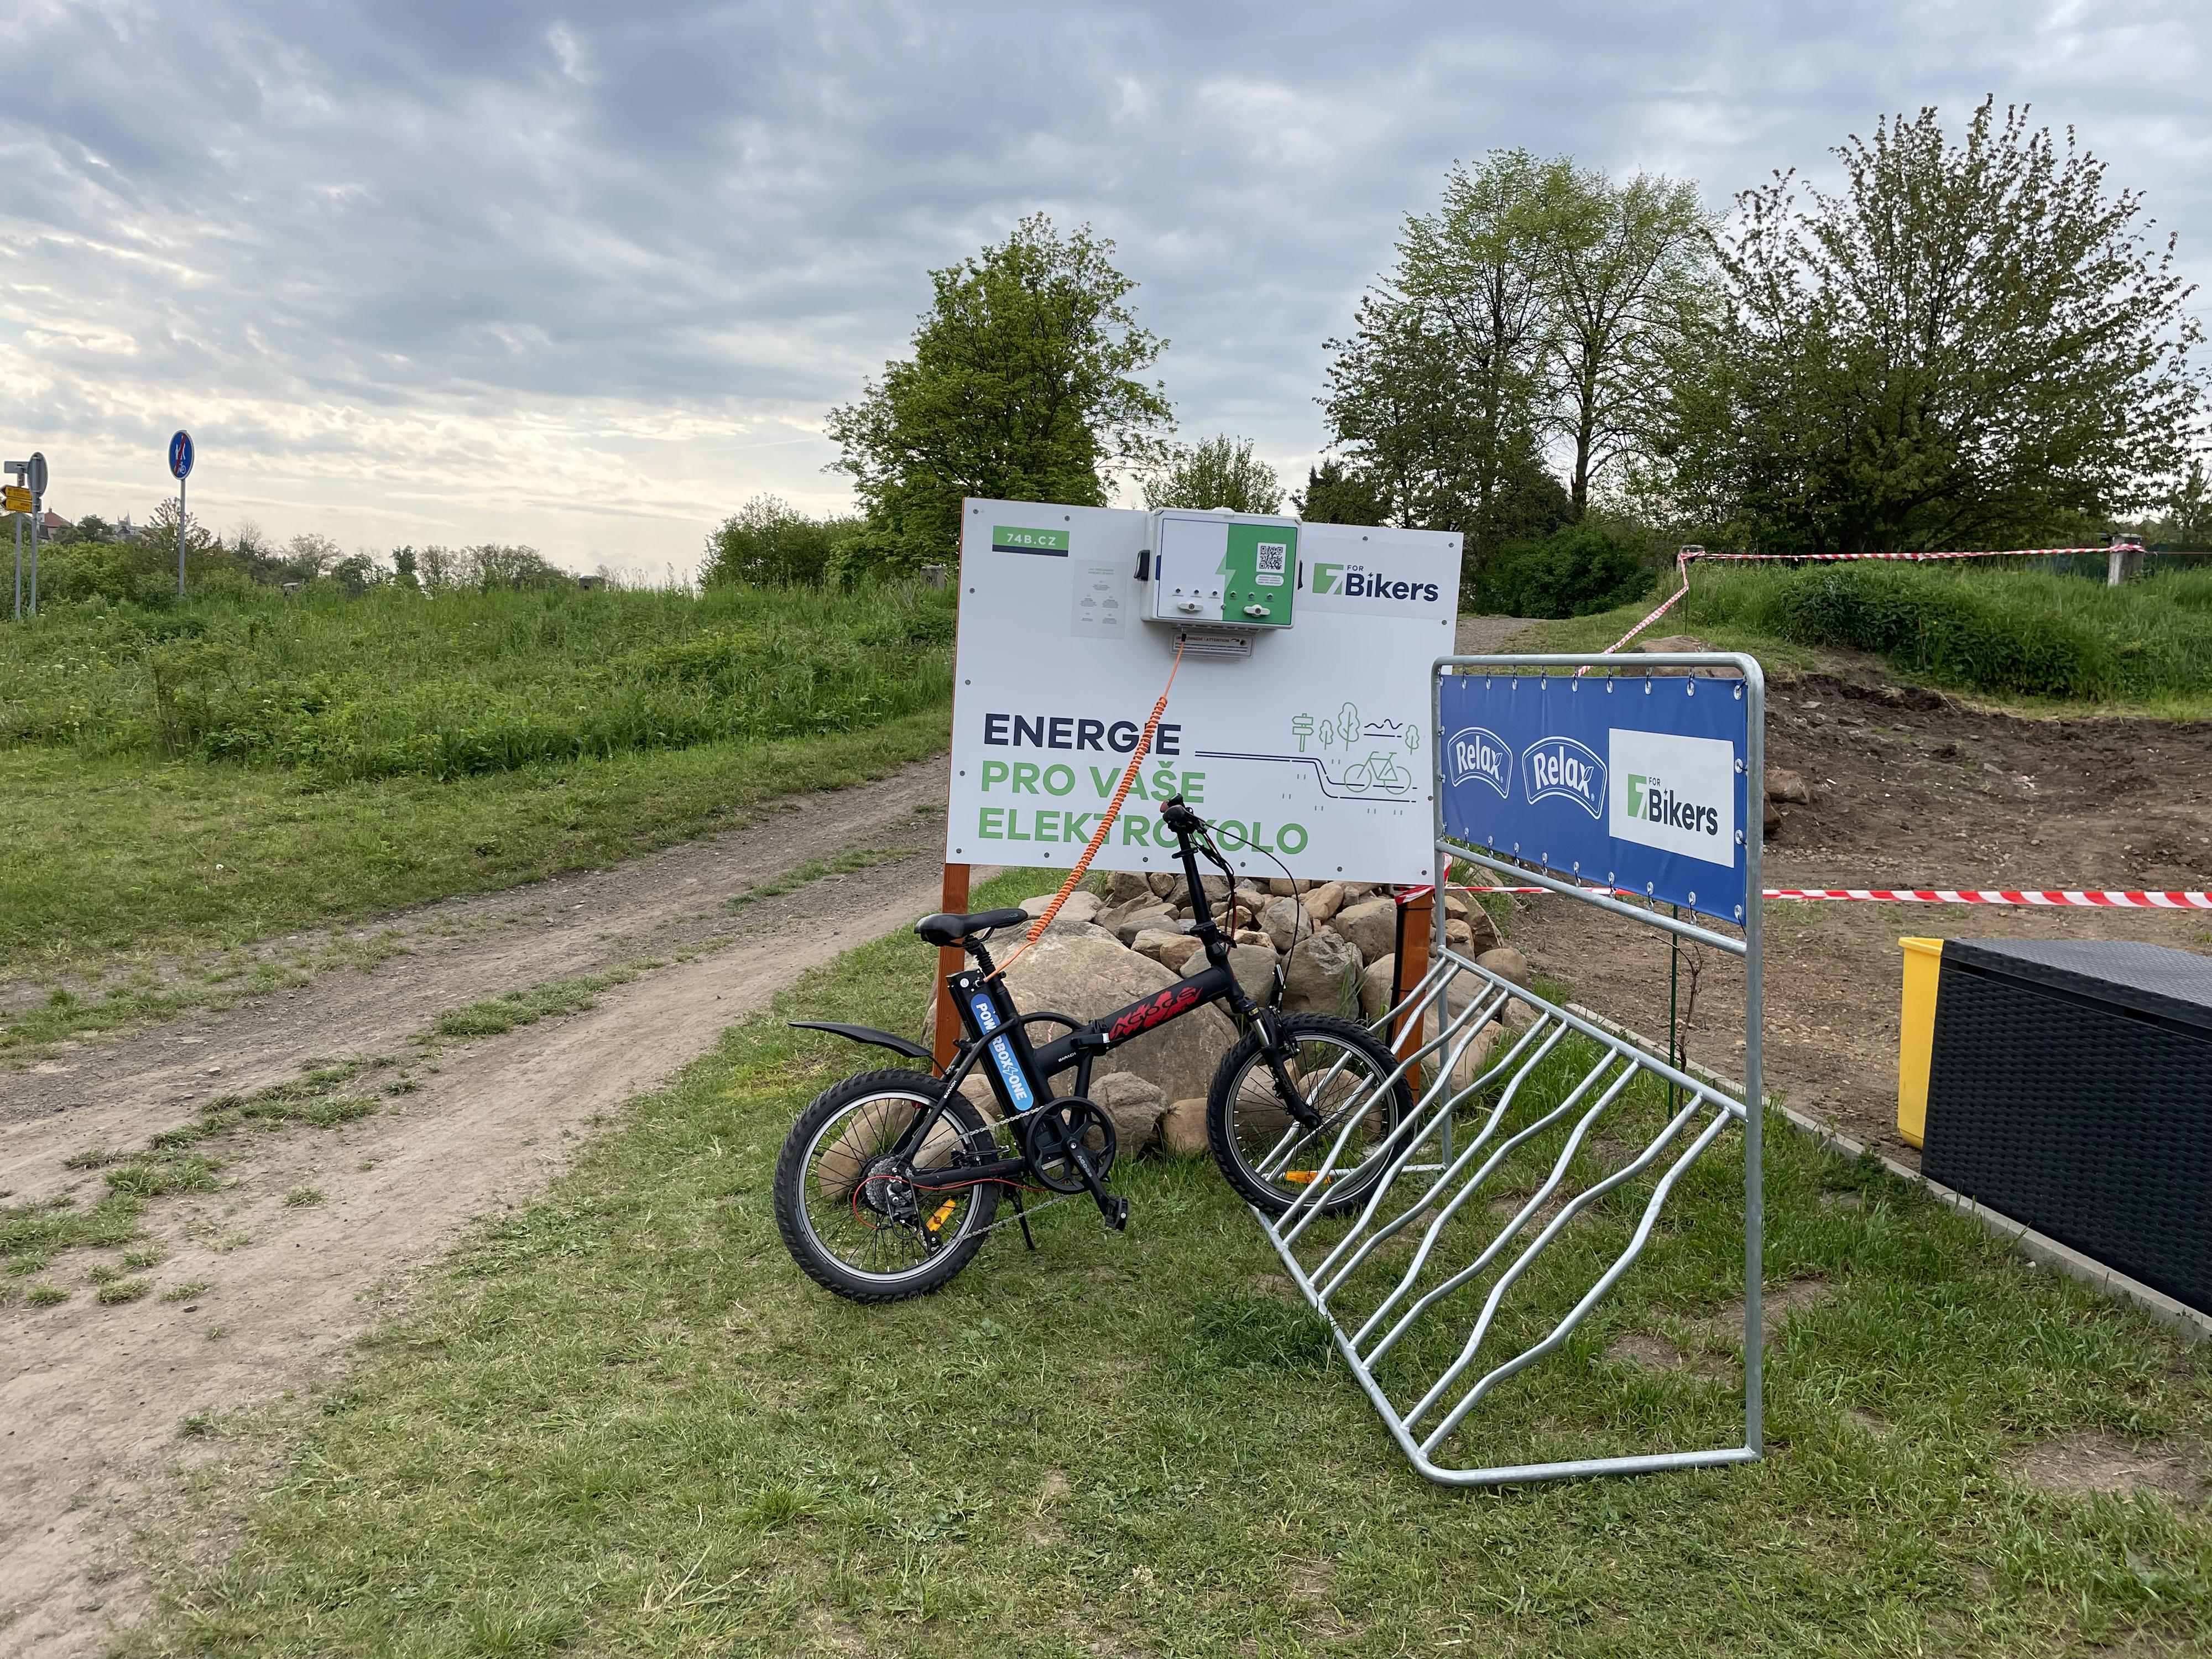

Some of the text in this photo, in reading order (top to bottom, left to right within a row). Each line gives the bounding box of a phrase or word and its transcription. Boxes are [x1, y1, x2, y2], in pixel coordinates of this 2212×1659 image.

[1007, 534, 1056, 546] 74B.CZ
[1345, 572, 1438, 602] Bikers
[1456, 735, 1503, 781] Relax
[1533, 746, 1594, 799] Relax
[982, 760, 1206, 804] PRO VAŠE
[1649, 777, 1661, 786] FOR
[1649, 788, 1718, 836] Bikers
[975, 1003, 1027, 1100] POWRBOX ONE
